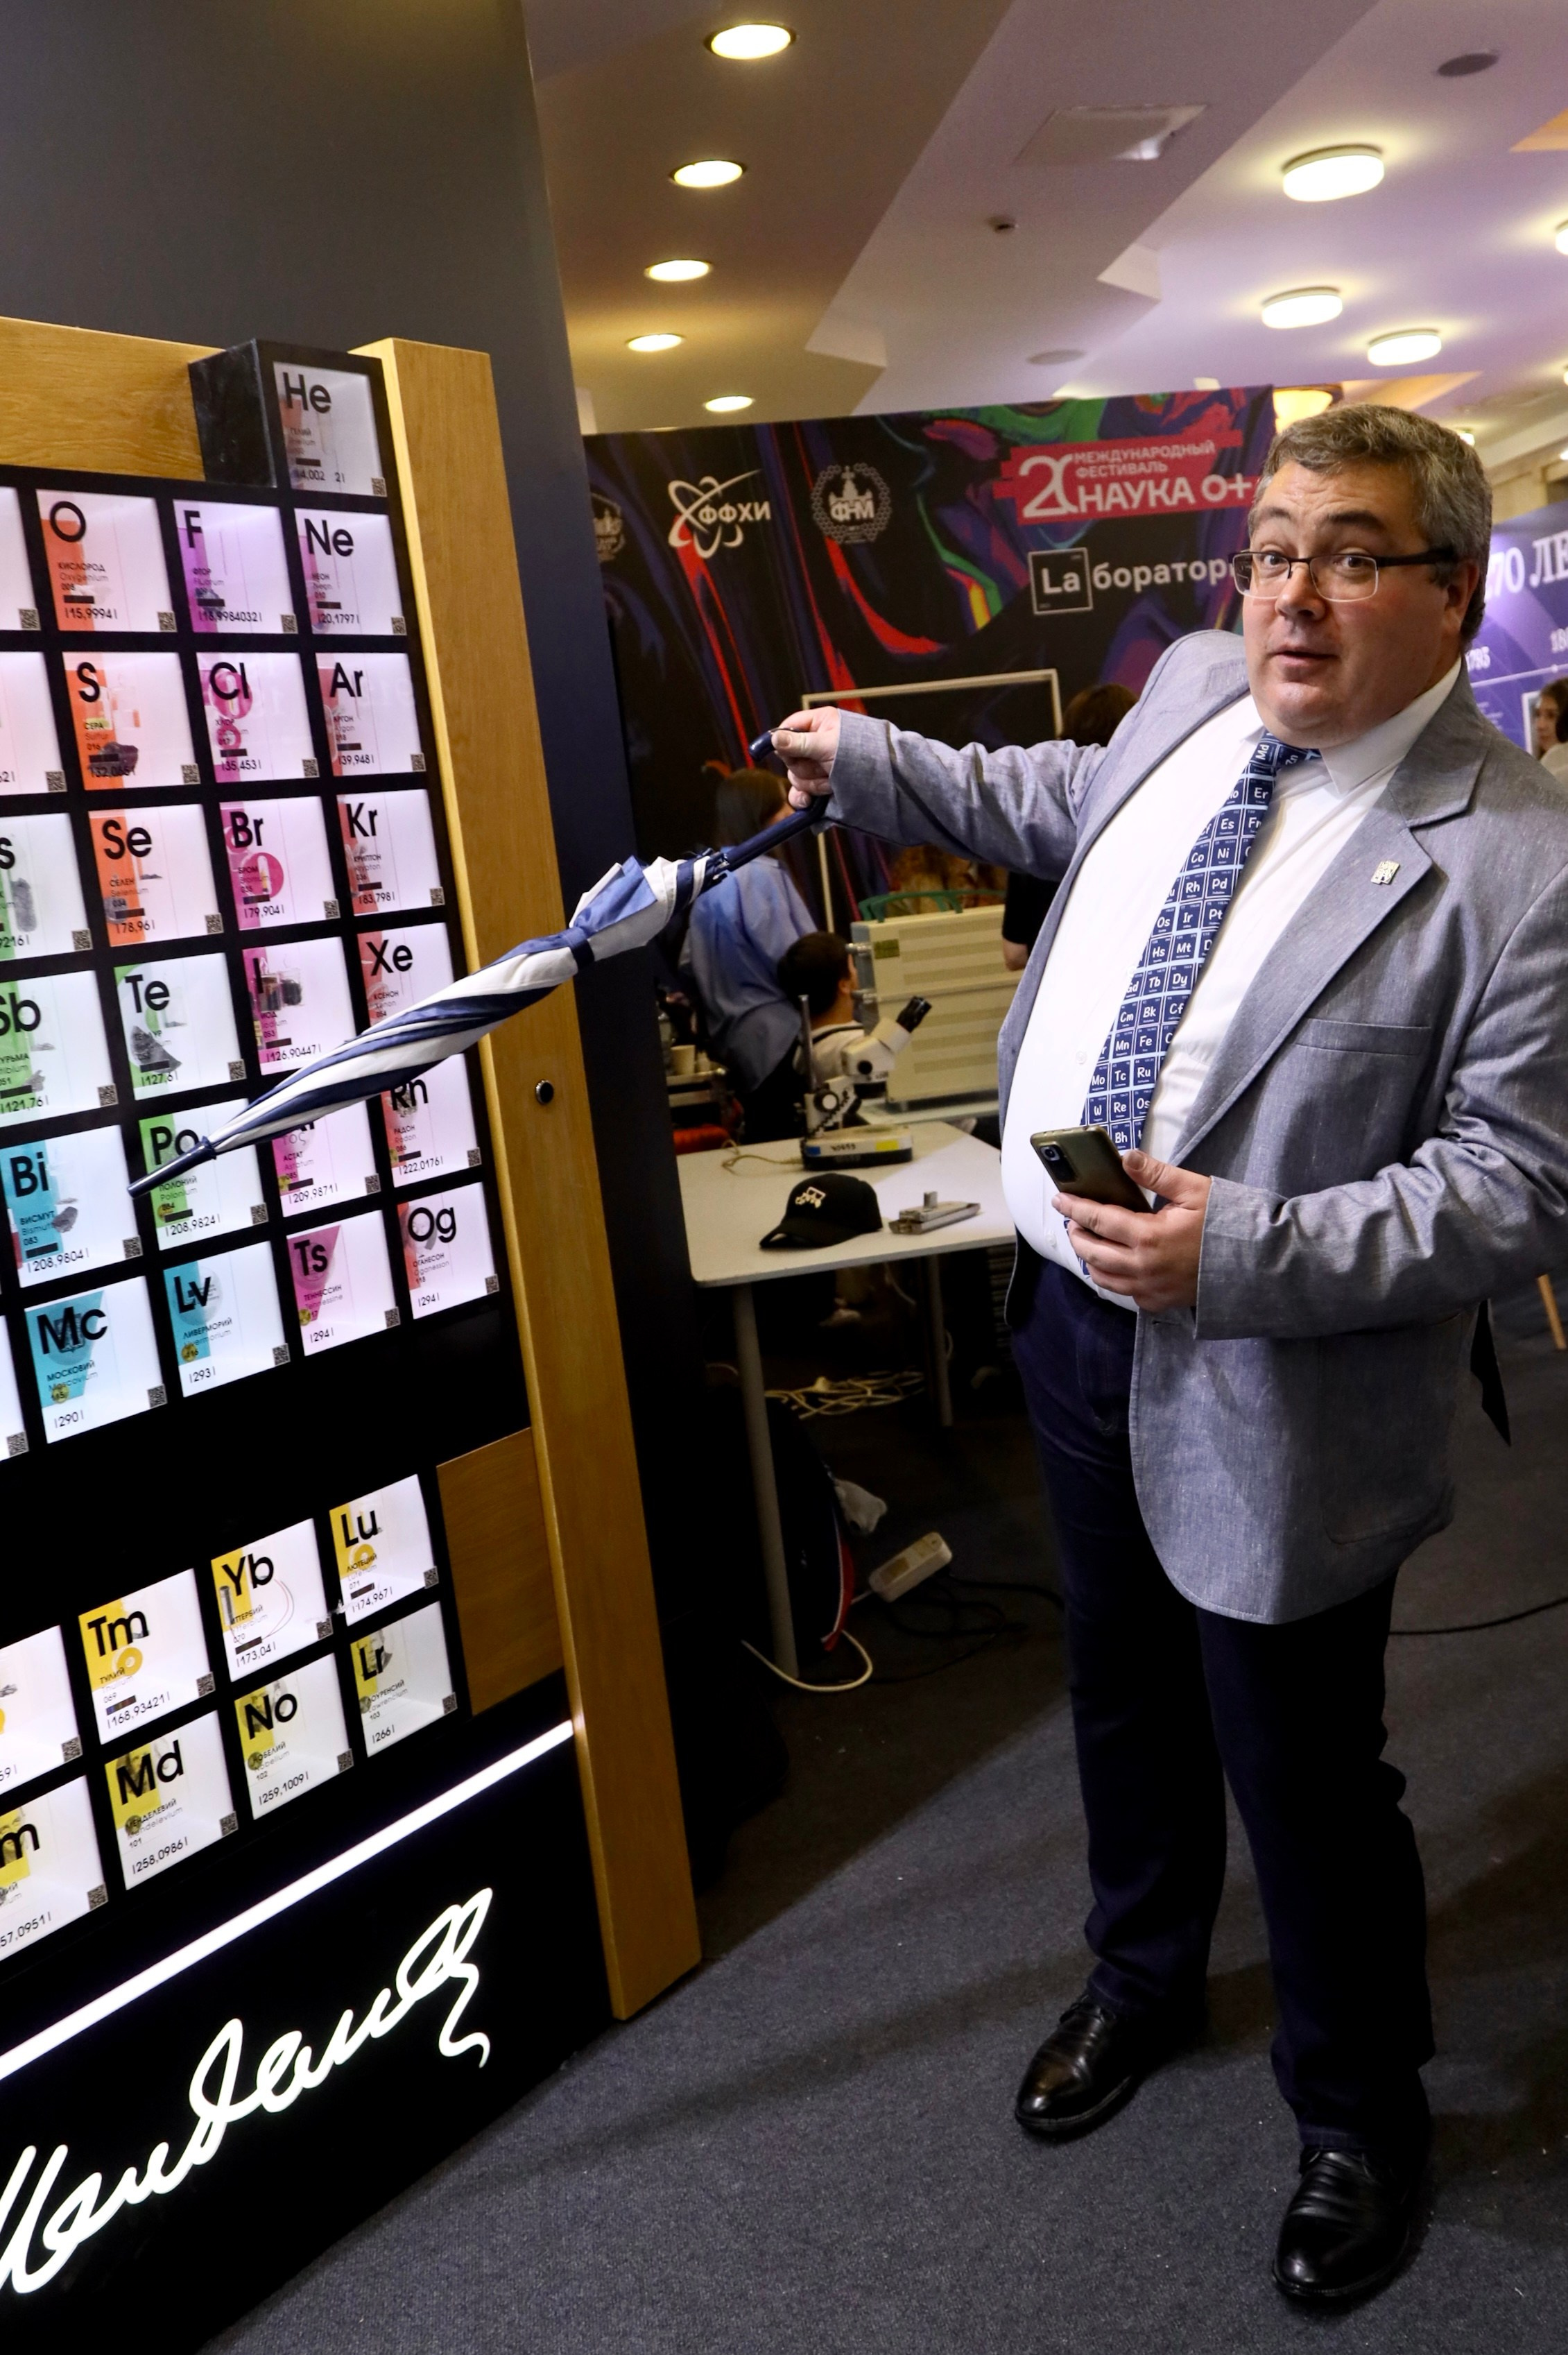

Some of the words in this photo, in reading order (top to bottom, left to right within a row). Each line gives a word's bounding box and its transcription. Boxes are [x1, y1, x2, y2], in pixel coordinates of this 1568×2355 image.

[282, 372, 331, 413] He
[1074, 439, 1216, 464] МЕЖДУНАРОДНЫЙ
[1076, 461, 1168, 478] ФЕСТИВАЛЬ
[1078, 476, 1196, 513] НАУКА
[49, 501, 86, 542] O
[184, 510, 203, 548] F
[304, 518, 354, 556] Ne
[58, 563, 105, 572] КИСЛОРОД
[77, 661, 101, 703] S
[210, 661, 250, 700] Cl
[329, 662, 363, 698] Ar
[84, 721, 105, 730] СЕРА
[1255, 744, 1270, 761] Md
[1254, 787, 1268, 799] Er
[346, 802, 378, 838] Kr
[1221, 818, 1235, 830] Es
[230, 810, 264, 848] Br
[102, 819, 152, 859] Se
[1191, 851, 1205, 864] Co
[1217, 848, 1230, 859] Ni
[110, 878, 135, 887] СЕЛЕН
[1185, 881, 1200, 893] Rh
[1212, 877, 1228, 890] Pd
[1157, 916, 1171, 928] Os
[1182, 911, 1193, 924] Ir
[1209, 908, 1223, 920] Pt
[1152, 945, 1166, 957] Hs
[1176, 941, 1191, 954] Mt
[366, 939, 413, 976] Xe
[1149, 976, 1161, 989] Tb
[1173, 973, 1189, 988] Dy
[125, 975, 170, 1013] Te
[374, 991, 399, 1000] КСЕНОН
[1120, 1011, 1134, 1023] Cm
[1143, 1007, 1157, 1018] Bk
[1169, 1003, 1184, 1015] Cf
[1115, 1040, 1130, 1052] Mn
[1139, 1036, 1153, 1048] Fe
[1092, 1075, 1105, 1086] Mo
[1114, 1070, 1127, 1081] Tc
[1137, 1067, 1151, 1078] Ru
[1094, 1105, 1103, 1116] W
[1113, 1102, 1127, 1113] Re
[1137, 1097, 1151, 1110] Os
[393, 1124, 415, 1134] РАДОН
[1114, 1131, 1128, 1143] Bh
[149, 1126, 199, 1165] Po
[284, 1151, 303, 1161] АСТАТ
[10, 1151, 49, 1197] Bi
[19, 1210, 55, 1226] ВИСМУТ
[408, 1207, 457, 1243] Og
[293, 1239, 328, 1276] Ts
[413, 1252, 445, 1268] ОГАНЕСОН
[173, 1276, 212, 1314] Lv
[304, 1285, 342, 1302] ТЕННЕССИН
[37, 1307, 108, 1355] Mc
[183, 1317, 233, 1339] ЛИВЕРМОРИЙ
[46, 1360, 96, 1382] МОСКОВИЙ
[341, 1510, 379, 1548] Lu
[222, 1553, 274, 1596] Yb
[87, 1610, 149, 1657] Tm
[359, 1644, 385, 1681] Lr
[99, 1666, 126, 1685] ТУЛИЙ
[244, 1693, 298, 1740] No
[116, 1739, 184, 1805] Md
